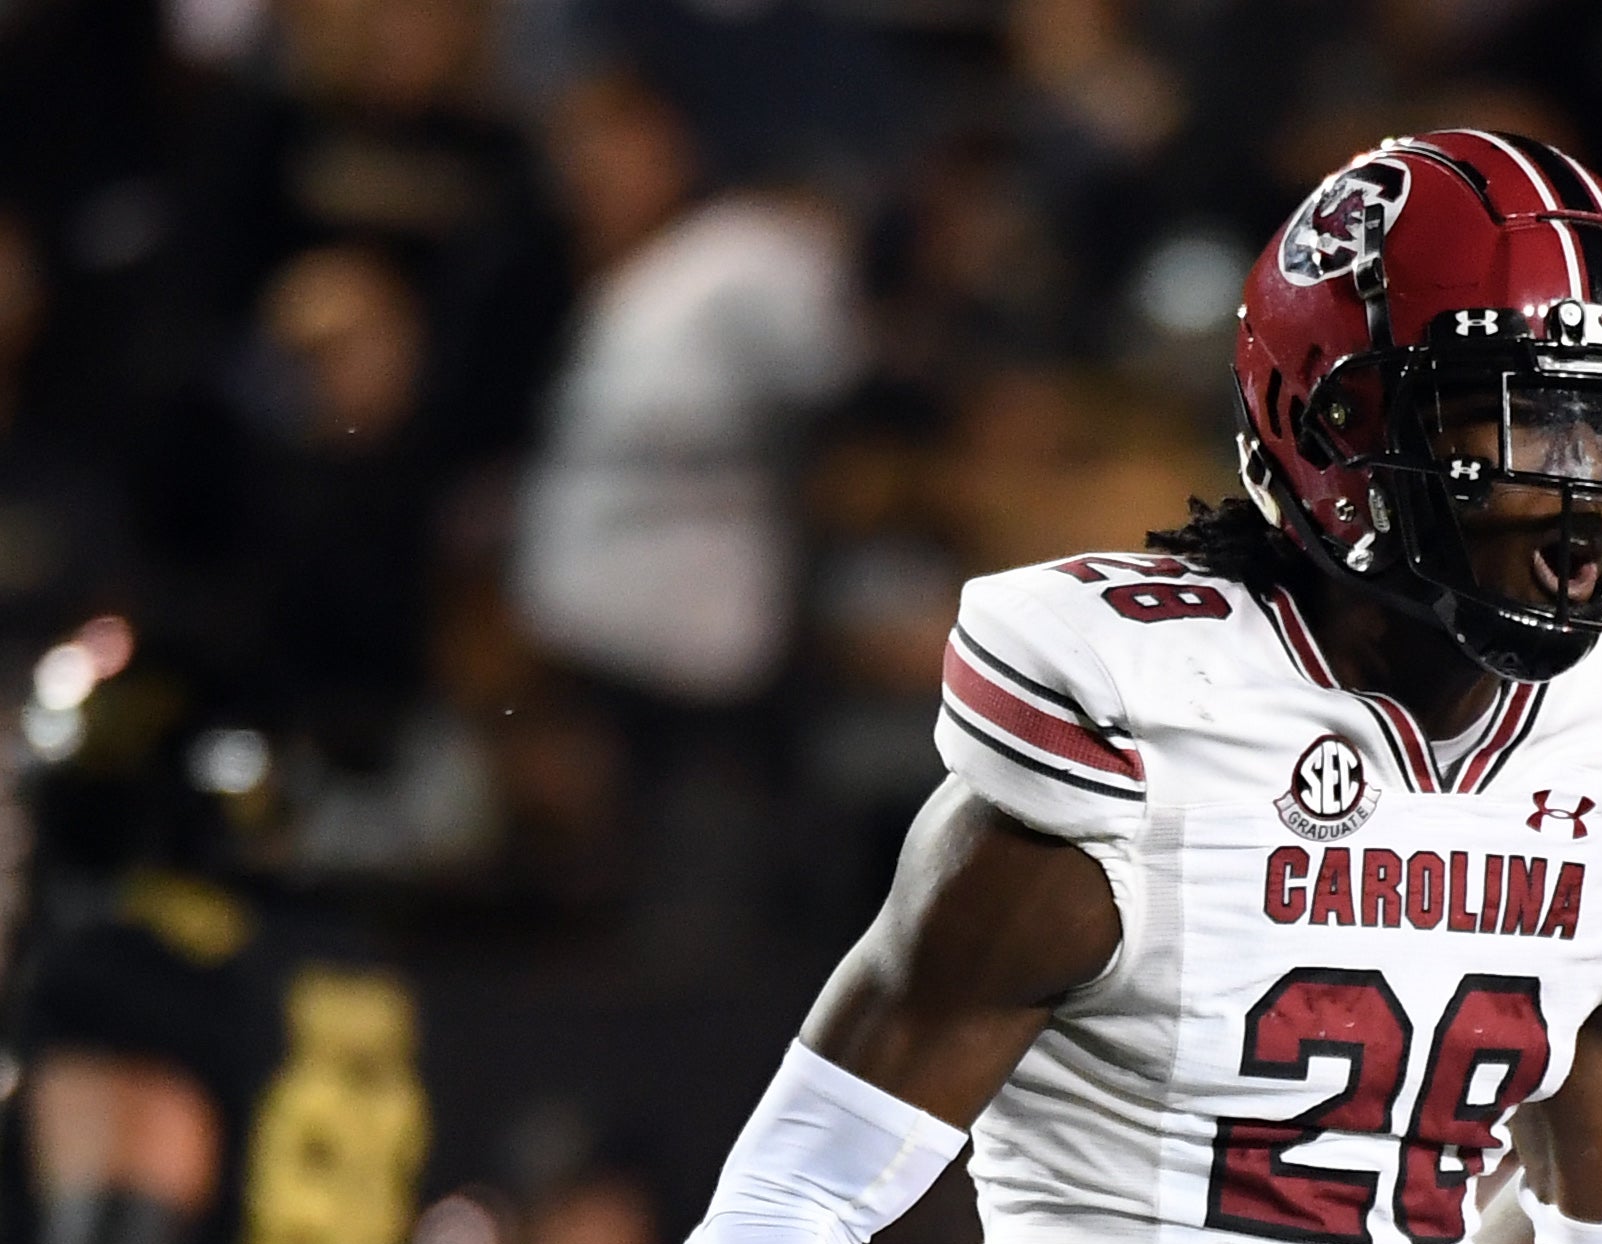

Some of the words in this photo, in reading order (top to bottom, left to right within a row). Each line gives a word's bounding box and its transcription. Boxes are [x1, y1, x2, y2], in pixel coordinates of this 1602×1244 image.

[1299, 739, 1359, 815] SEC
[1287, 805, 1370, 840] GRADUATE
[1263, 846, 1586, 941] CAROLINA
